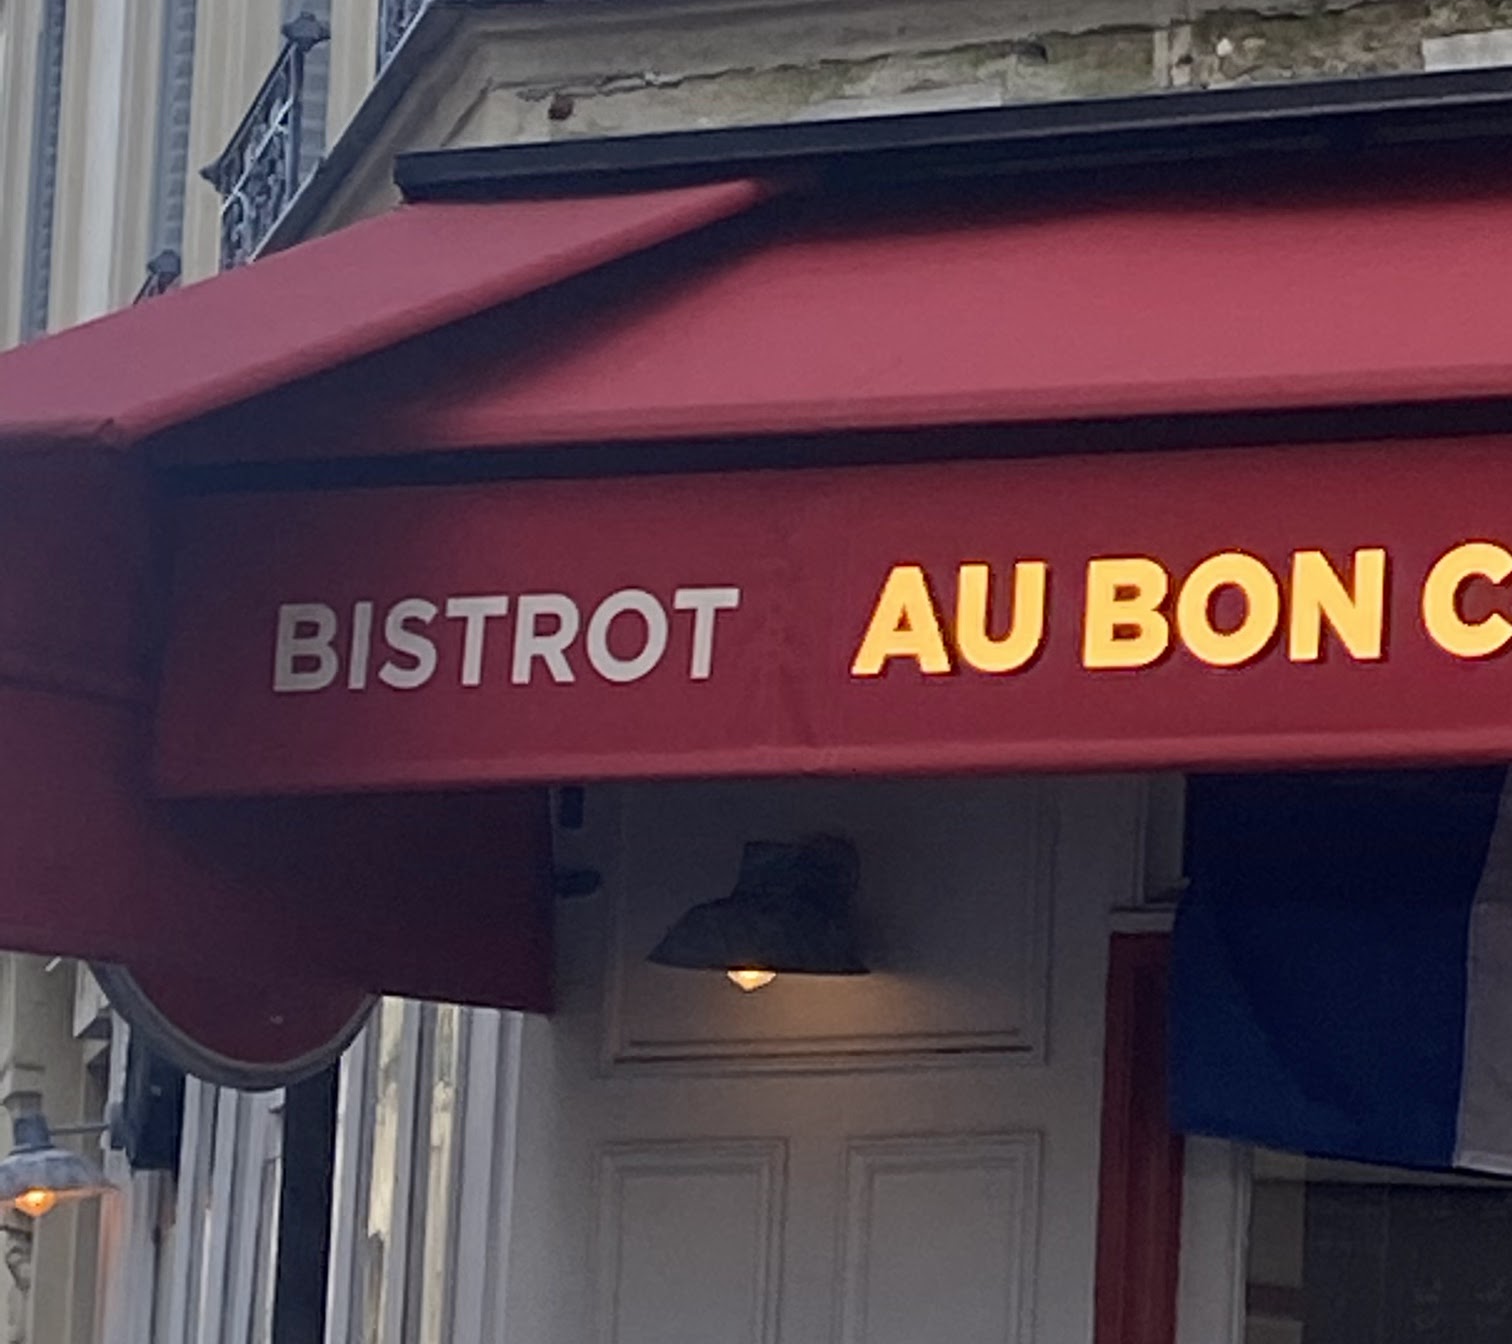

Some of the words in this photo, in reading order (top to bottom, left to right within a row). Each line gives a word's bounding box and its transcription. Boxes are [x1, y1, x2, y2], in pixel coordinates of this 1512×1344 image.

[272, 587, 740, 692] BISTROT
[850, 559, 1049, 678] AU
[1081, 548, 1389, 670] BON
